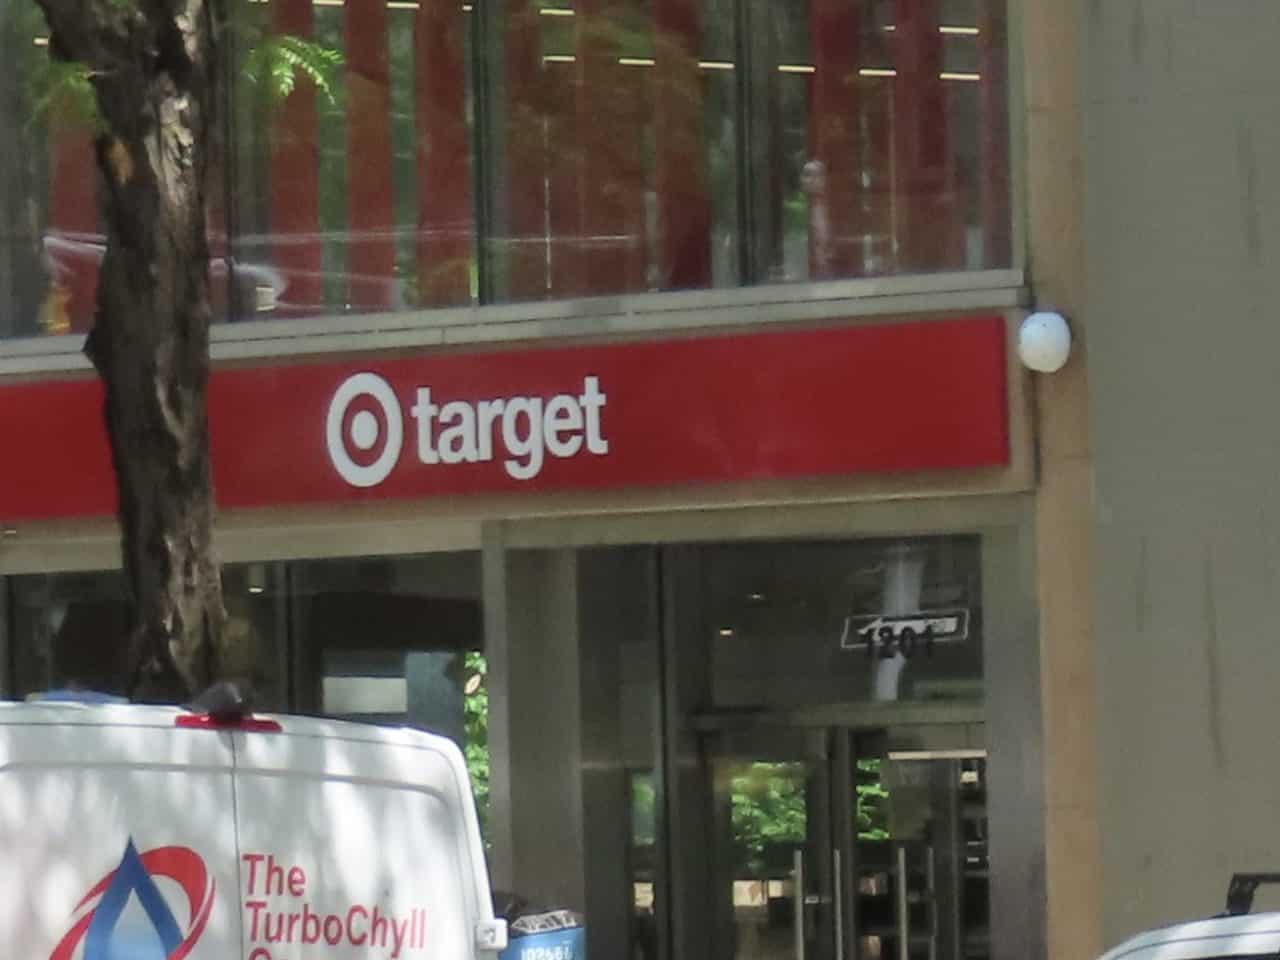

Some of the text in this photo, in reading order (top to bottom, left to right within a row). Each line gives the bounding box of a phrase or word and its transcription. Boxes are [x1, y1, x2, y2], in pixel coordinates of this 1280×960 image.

[411, 376, 609, 480] target
[242, 853, 306, 896] The
[244, 901, 426, 959] TurboChyll
